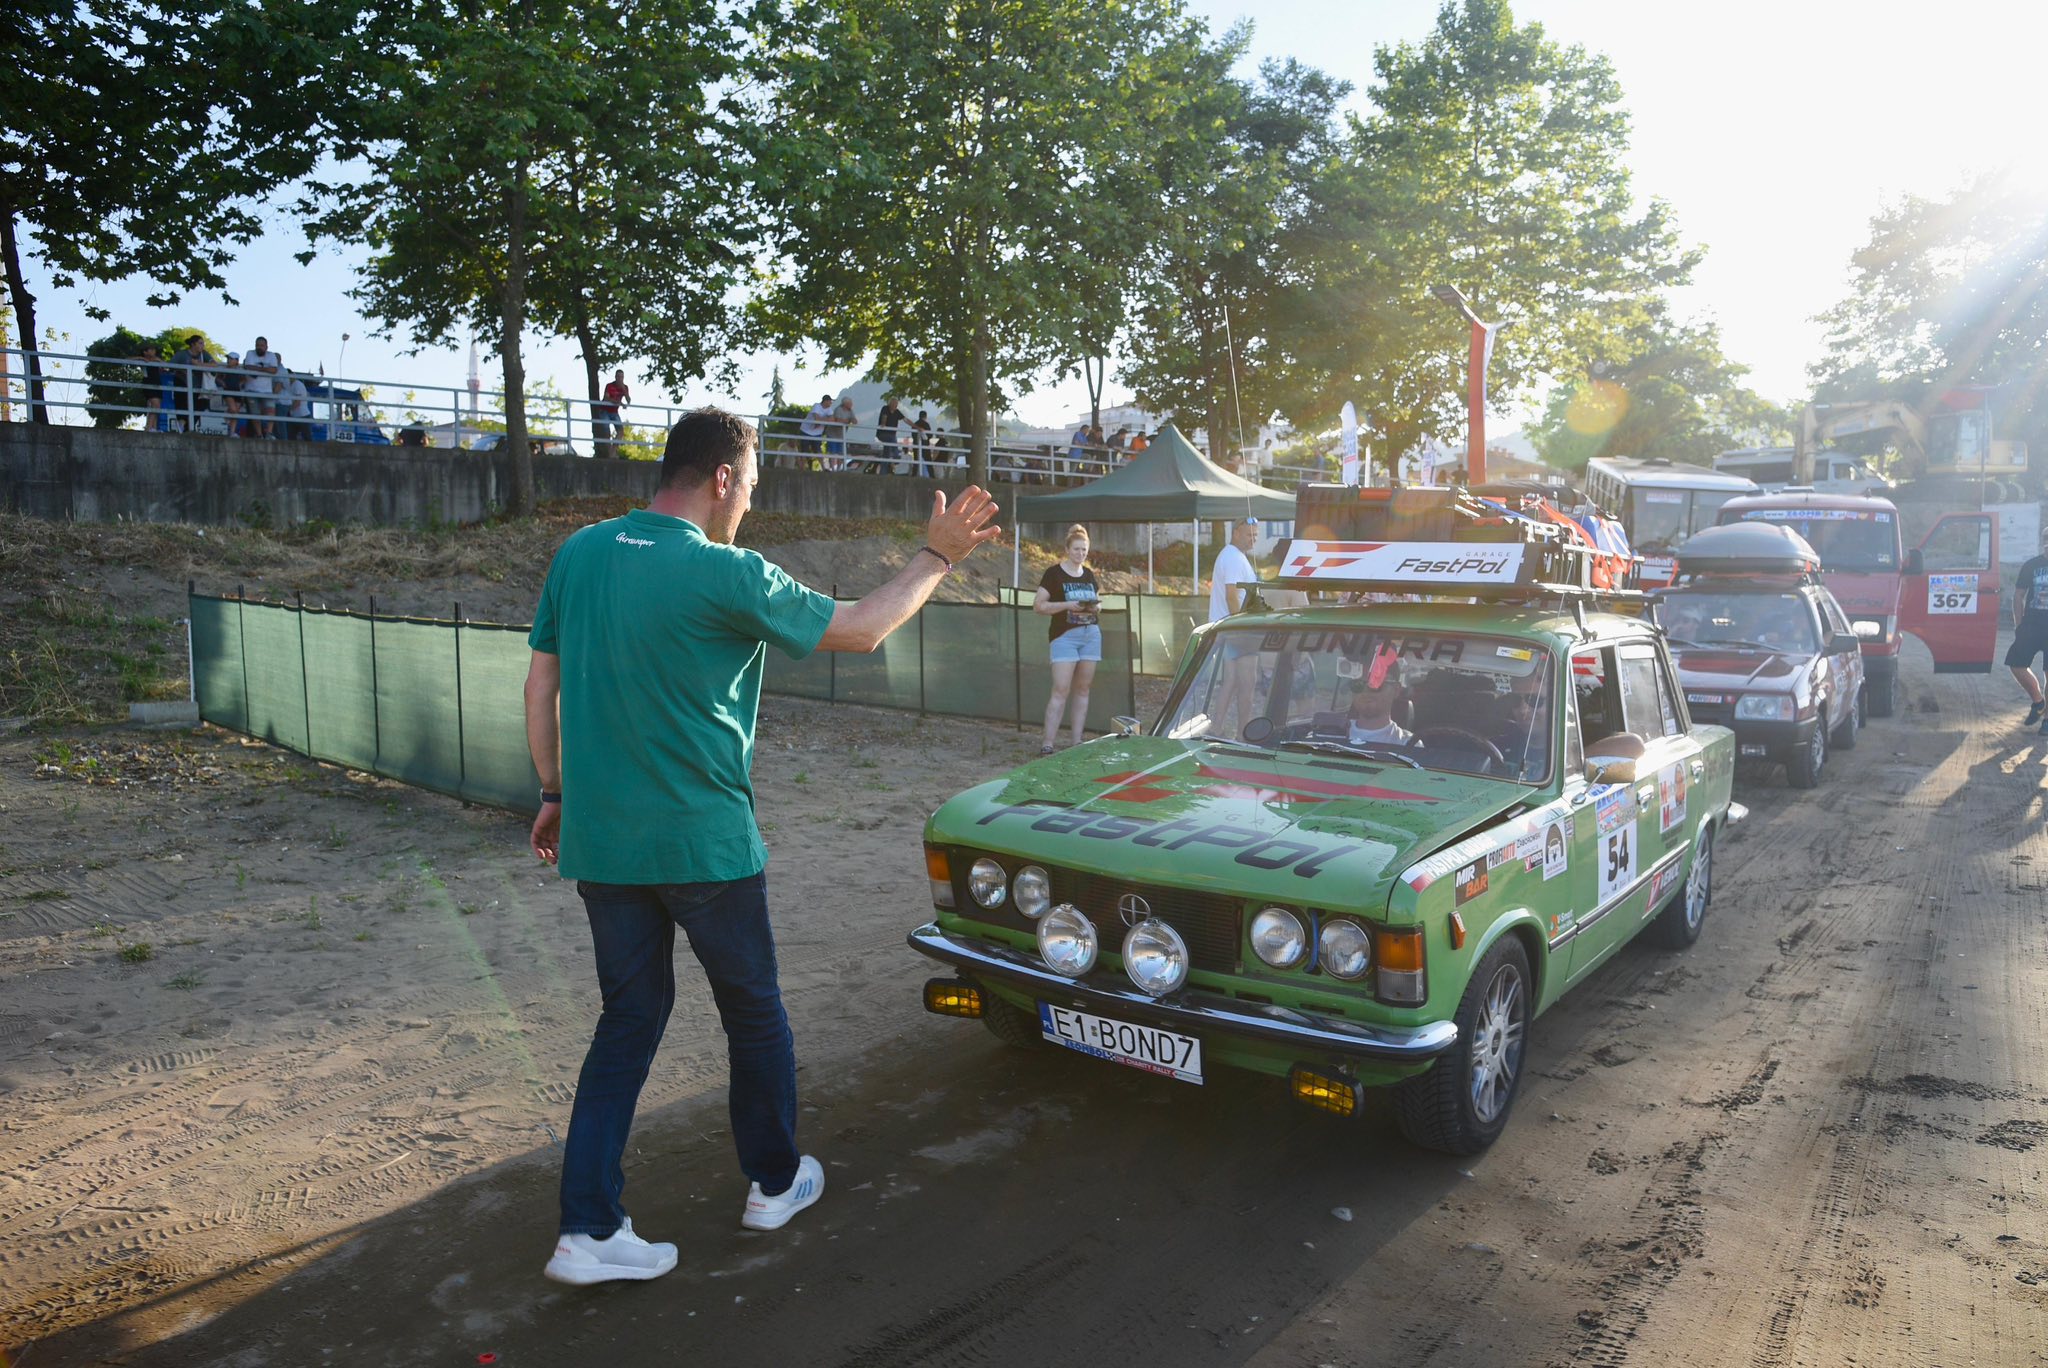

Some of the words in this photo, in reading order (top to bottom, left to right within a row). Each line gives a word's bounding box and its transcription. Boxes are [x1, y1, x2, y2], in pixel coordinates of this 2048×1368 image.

[1395, 558, 1508, 574] FastPol
[1933, 594, 1972, 608] 367
[976, 800, 1362, 879] FastPol
[1608, 829, 1629, 882] 54
[1456, 864, 1476, 888] MIR
[1466, 874, 1488, 898] BAR
[1054, 1008, 1086, 1042] E1
[1100, 1019, 1194, 1069] BOND7
[1126, 1058, 1151, 1071] CHARITY
[1152, 1065, 1173, 1076] RALLY
